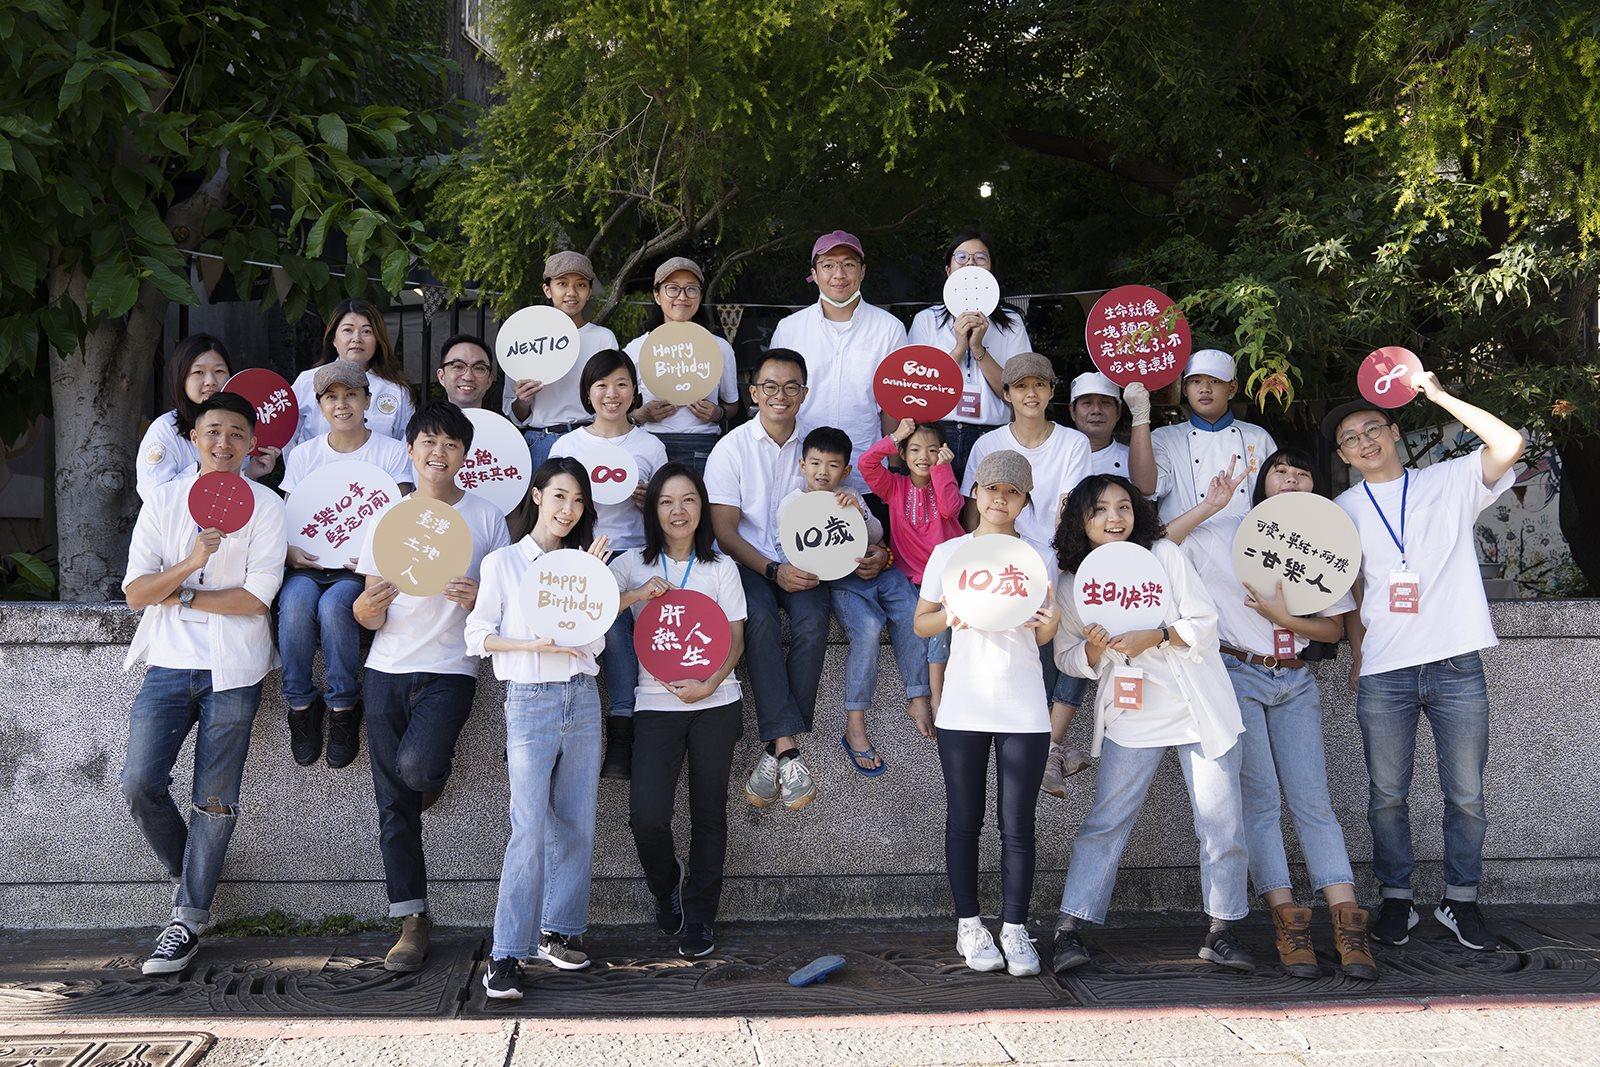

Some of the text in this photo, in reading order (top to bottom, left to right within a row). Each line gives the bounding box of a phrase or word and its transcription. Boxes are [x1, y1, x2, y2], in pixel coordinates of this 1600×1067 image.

[1104, 299, 1160, 320] 生命就像
[652, 342, 694, 359] Happy
[655, 358, 711, 379] Birthday
[903, 360, 940, 378] Bon
[1109, 351, 1176, 375] 吃也會壞掉
[882, 378, 956, 395] anniversaire
[256, 388, 292, 424] 快樂
[300, 482, 366, 539] 甘樂10年
[325, 489, 390, 549] 堅定向前
[416, 509, 451, 535] 臺灣
[795, 515, 855, 552] 10歲
[403, 537, 440, 561] 土地
[400, 565, 418, 585] 人
[539, 571, 588, 593] Happy
[958, 564, 1030, 598] 10歲
[537, 590, 604, 620] Birthday
[1082, 577, 1164, 610] 生日快樂
